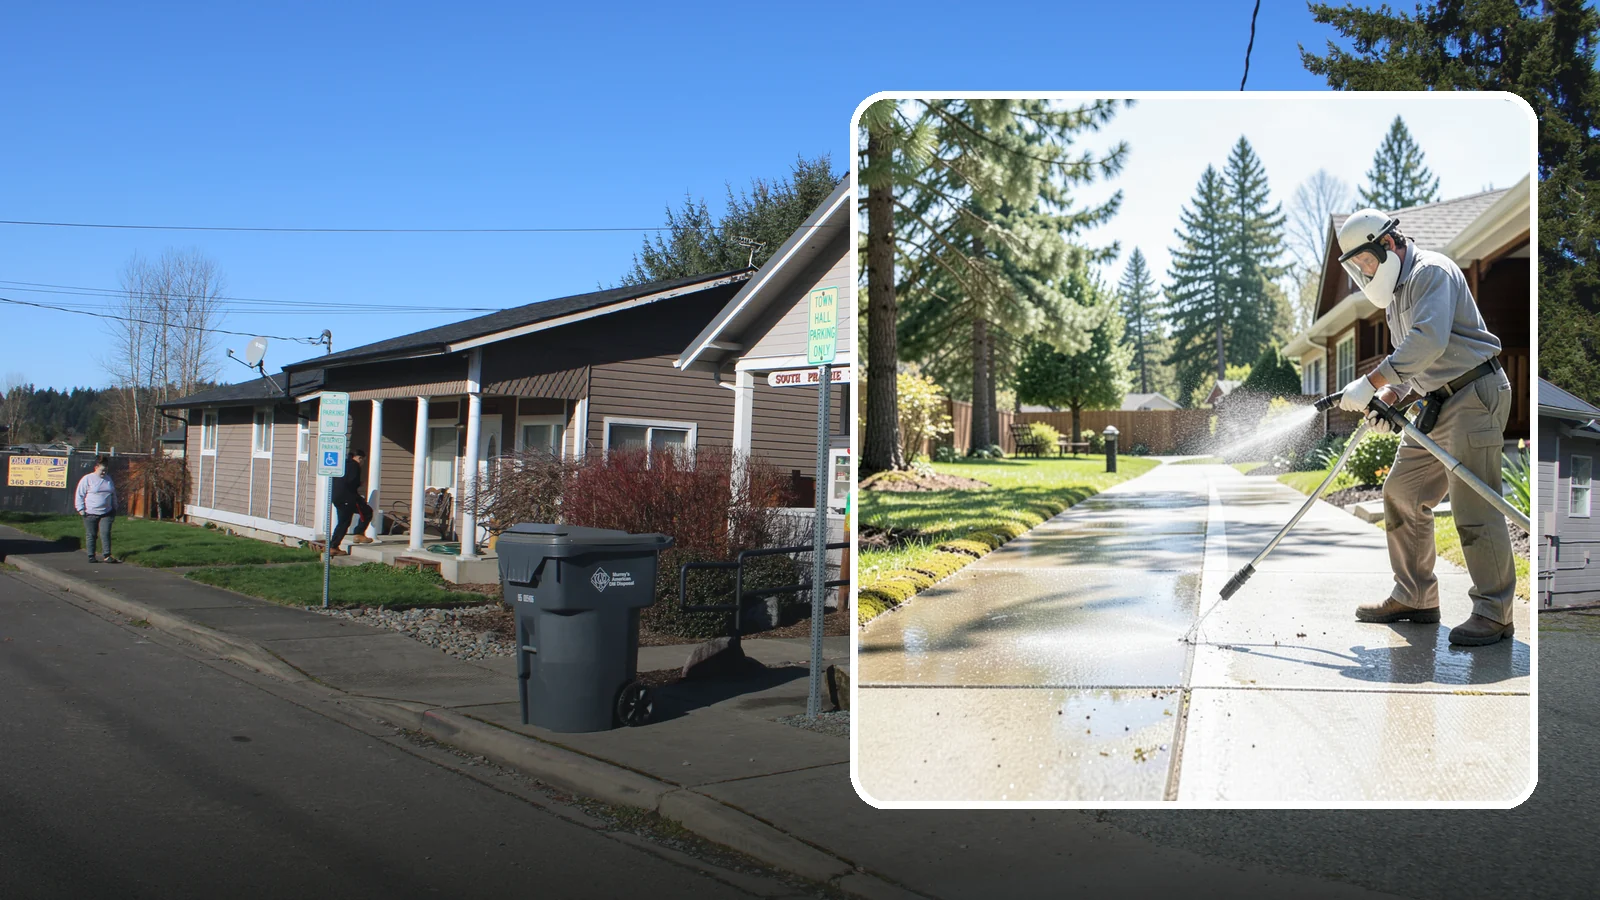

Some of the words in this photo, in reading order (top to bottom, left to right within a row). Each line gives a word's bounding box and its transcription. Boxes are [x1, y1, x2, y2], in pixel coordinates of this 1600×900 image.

[815, 295, 832, 307] TOWN
[814, 312, 831, 324] HALL
[810, 327, 835, 340] PARKING
[813, 344, 830, 357] ONLY
[775, 373, 801, 384] SOUTH
[807, 371, 842, 382] PRIE
